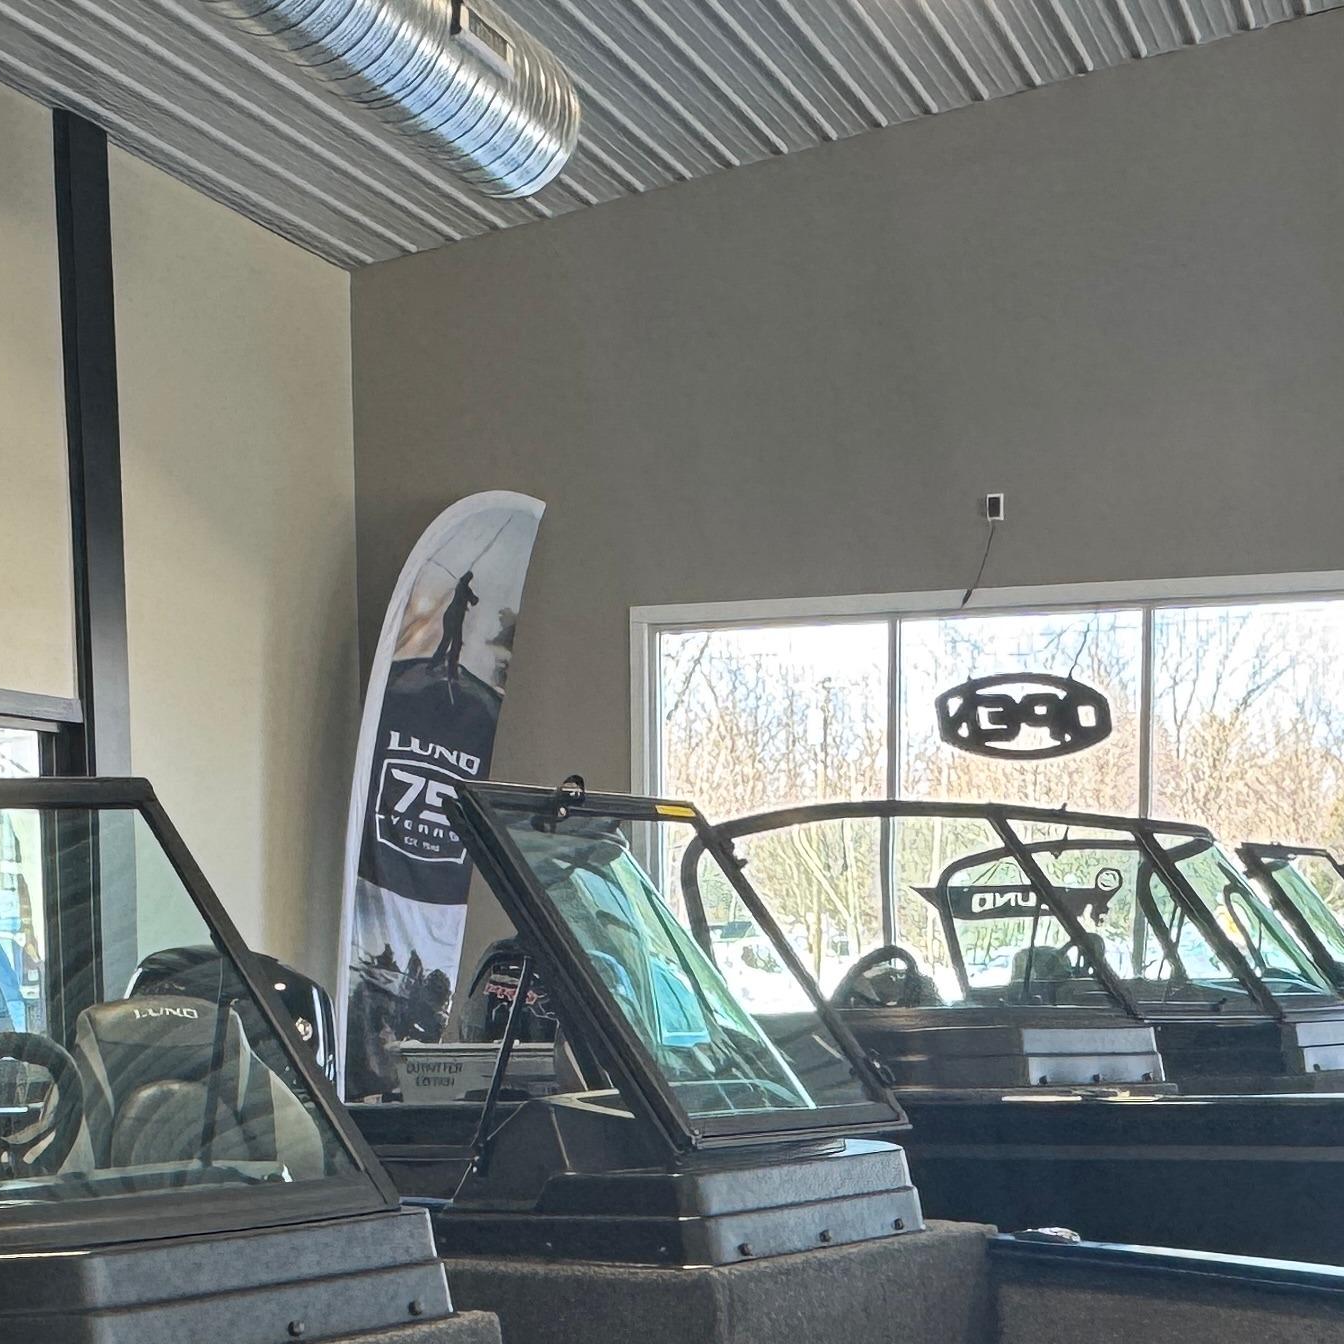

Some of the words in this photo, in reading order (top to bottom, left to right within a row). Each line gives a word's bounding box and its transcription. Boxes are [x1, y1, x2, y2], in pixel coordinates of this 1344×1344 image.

[387, 730, 481, 776] LUND
[390, 768, 459, 827] 75
[133, 1007, 199, 1020] LUND
